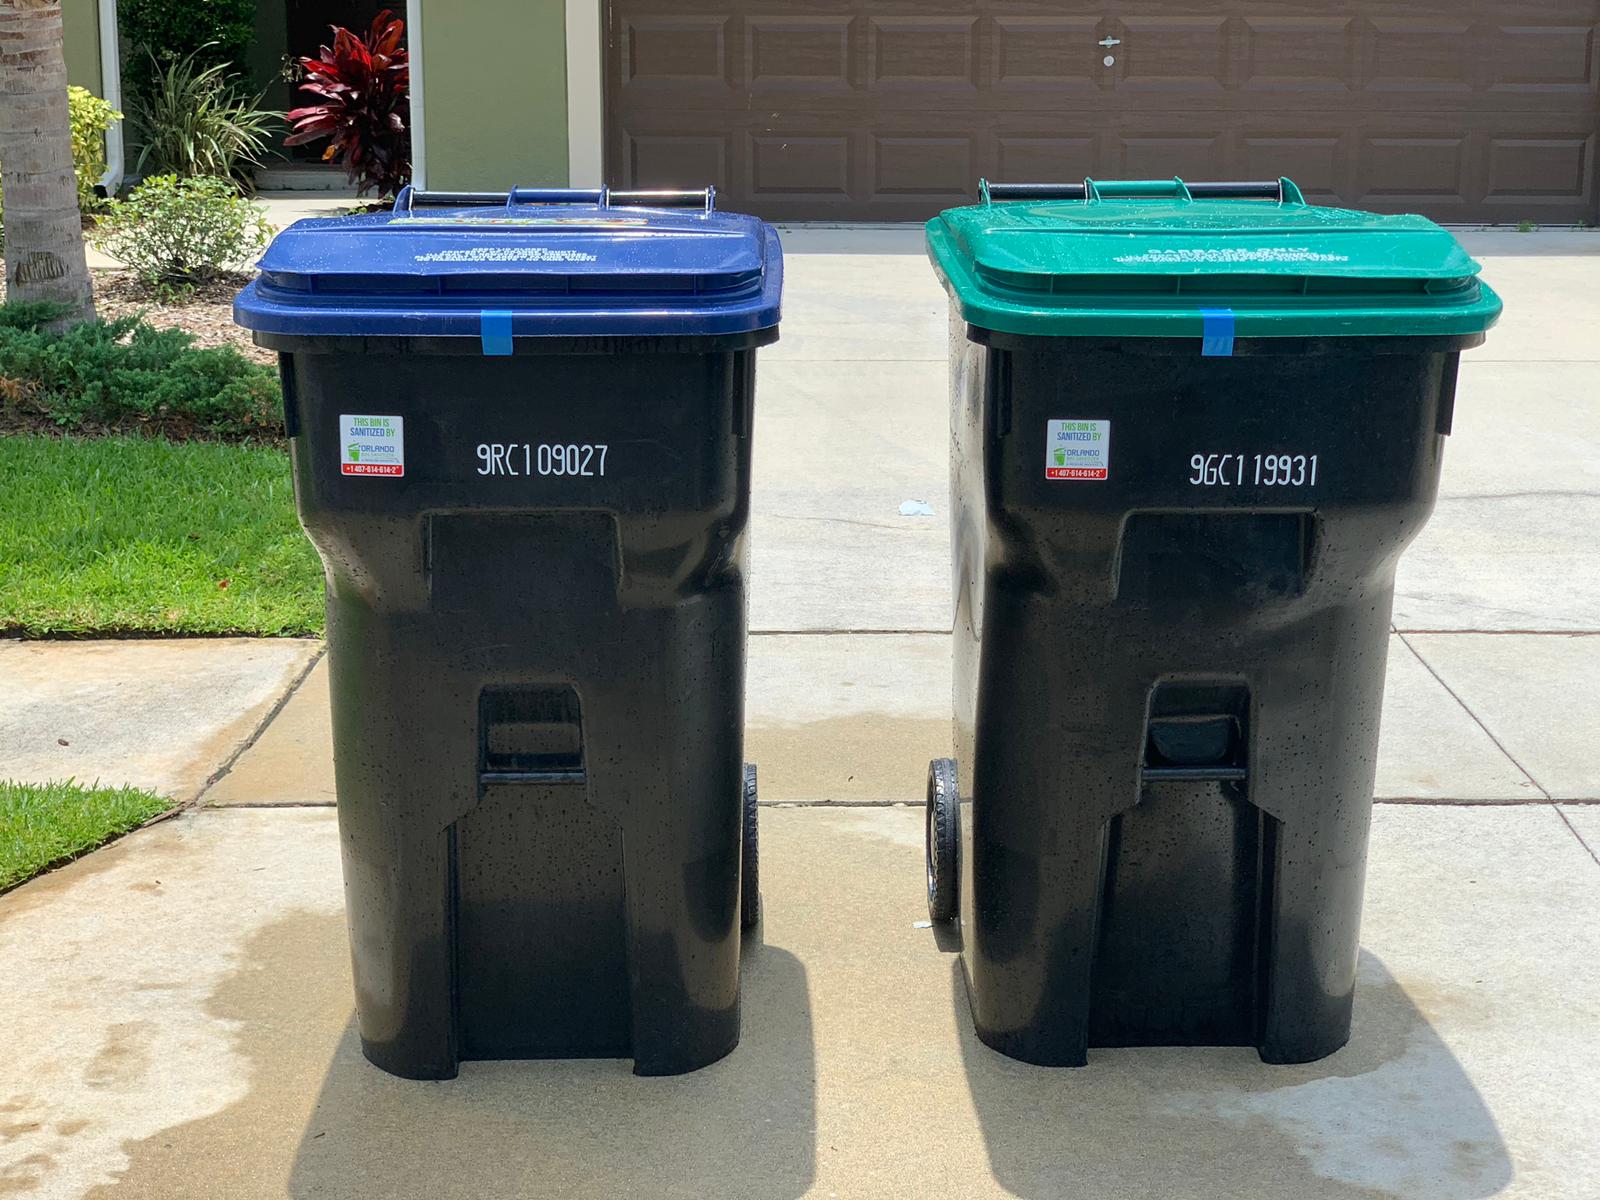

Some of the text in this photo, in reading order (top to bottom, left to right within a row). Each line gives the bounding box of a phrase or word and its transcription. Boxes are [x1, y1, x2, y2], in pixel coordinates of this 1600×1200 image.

[353, 417, 390, 427] THIS BIN IS
[1061, 422, 1097, 431] THIS BIN IS
[350, 427, 396, 437] SANITIZED BY
[1057, 431, 1101, 441] SANITIZED BY
